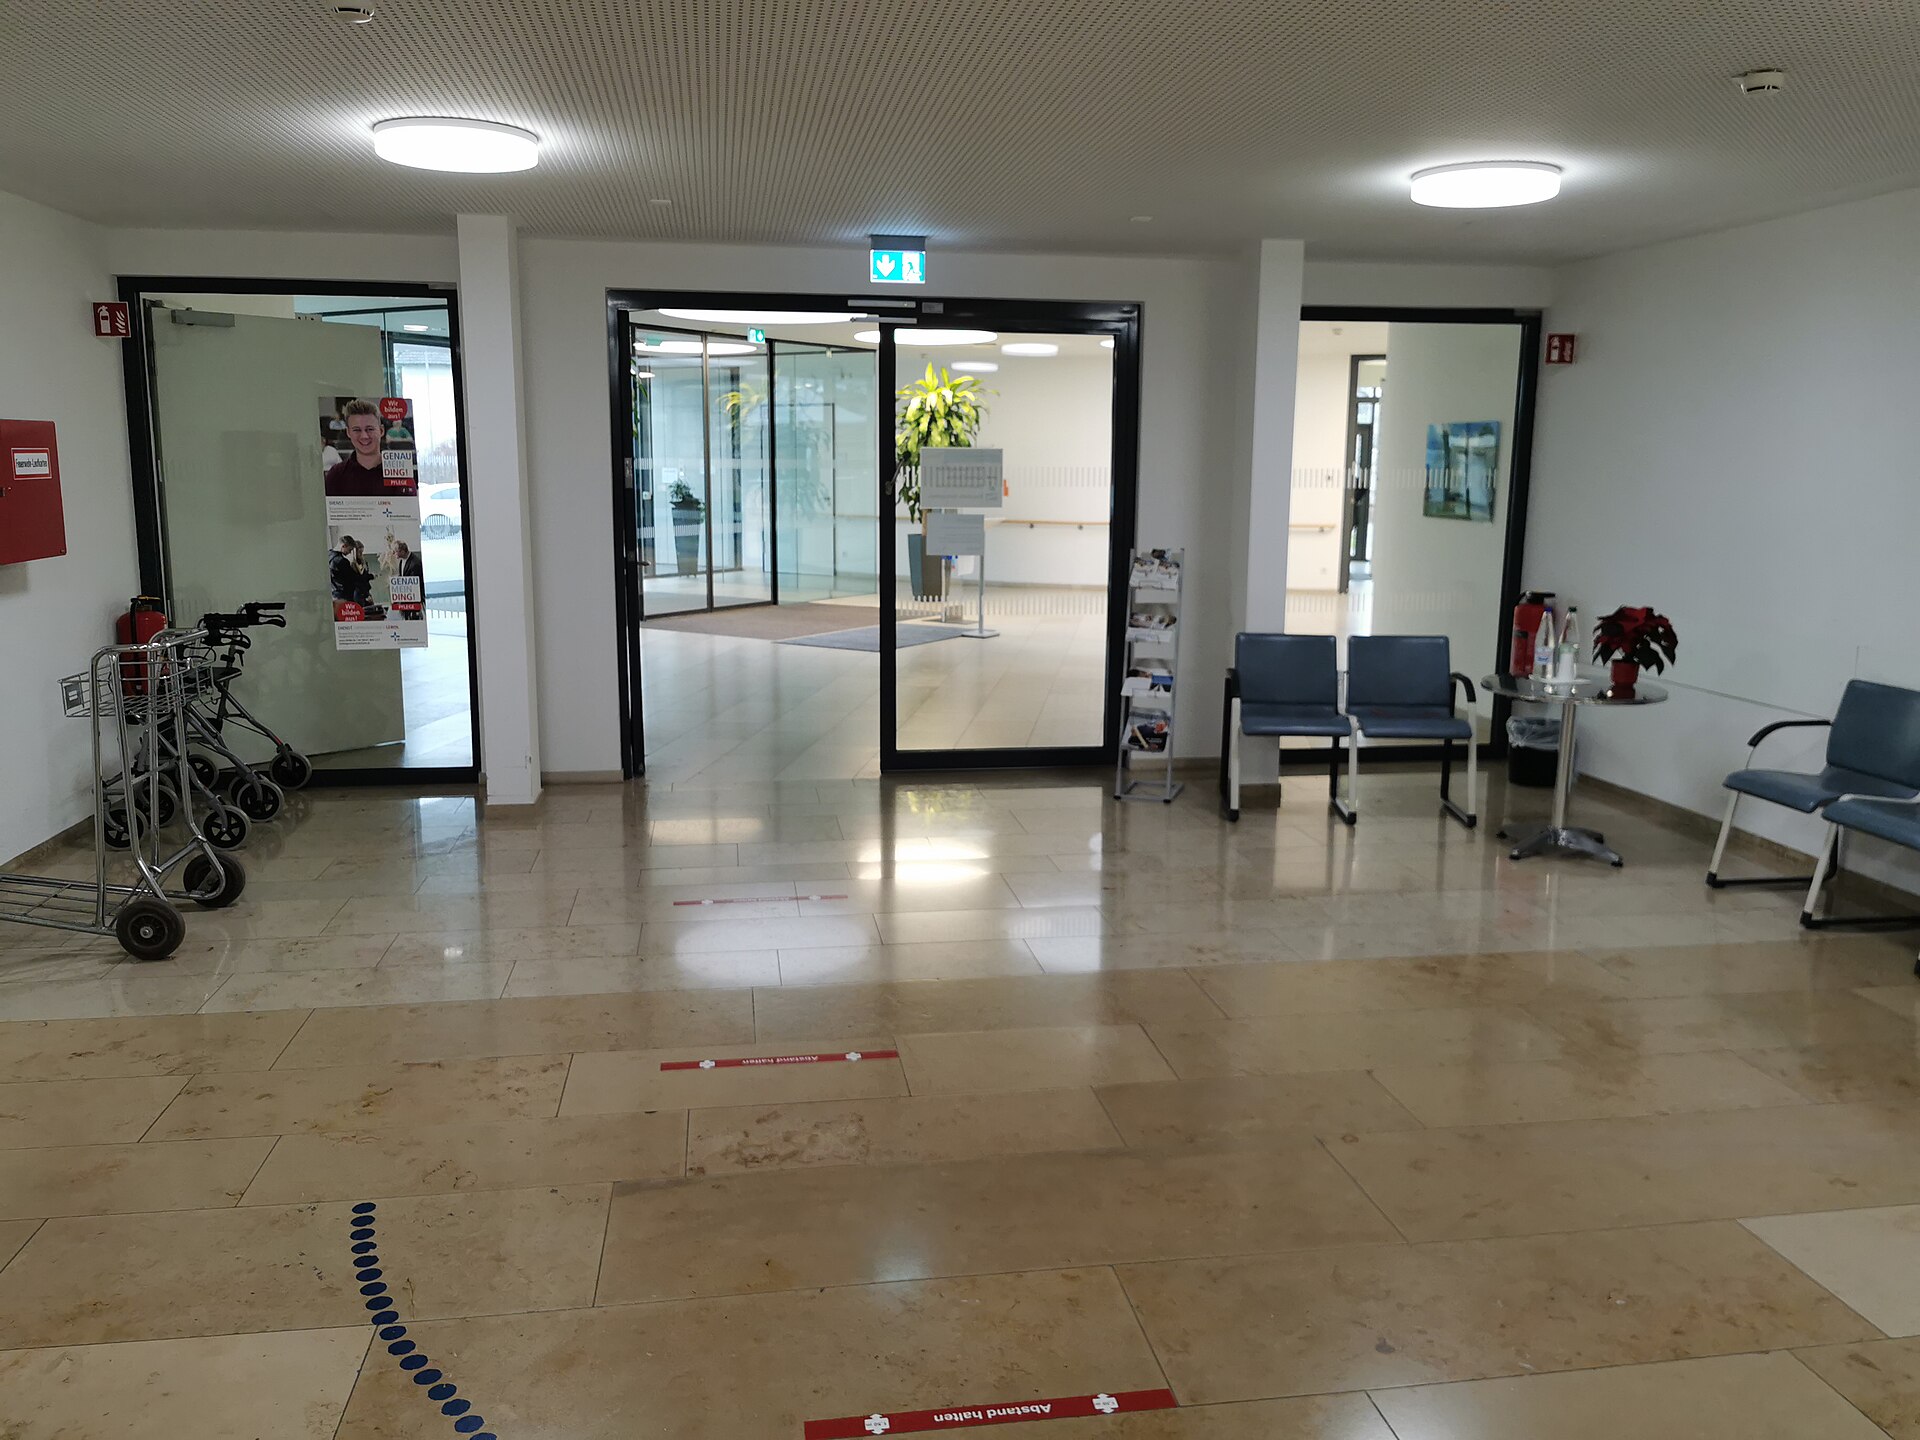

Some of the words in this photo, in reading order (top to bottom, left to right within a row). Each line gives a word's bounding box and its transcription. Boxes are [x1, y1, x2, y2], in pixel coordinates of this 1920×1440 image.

[383, 452, 411, 460] GENAU
[383, 460, 404, 468] MEIN
[390, 577, 419, 585] GENAU
[391, 585, 412, 593] MEIN
[392, 593, 416, 601] DING!
[776, 1055, 818, 1063] Abstand
[986, 1403, 1052, 1419] Abstand
[933, 1410, 983, 1422] halten
